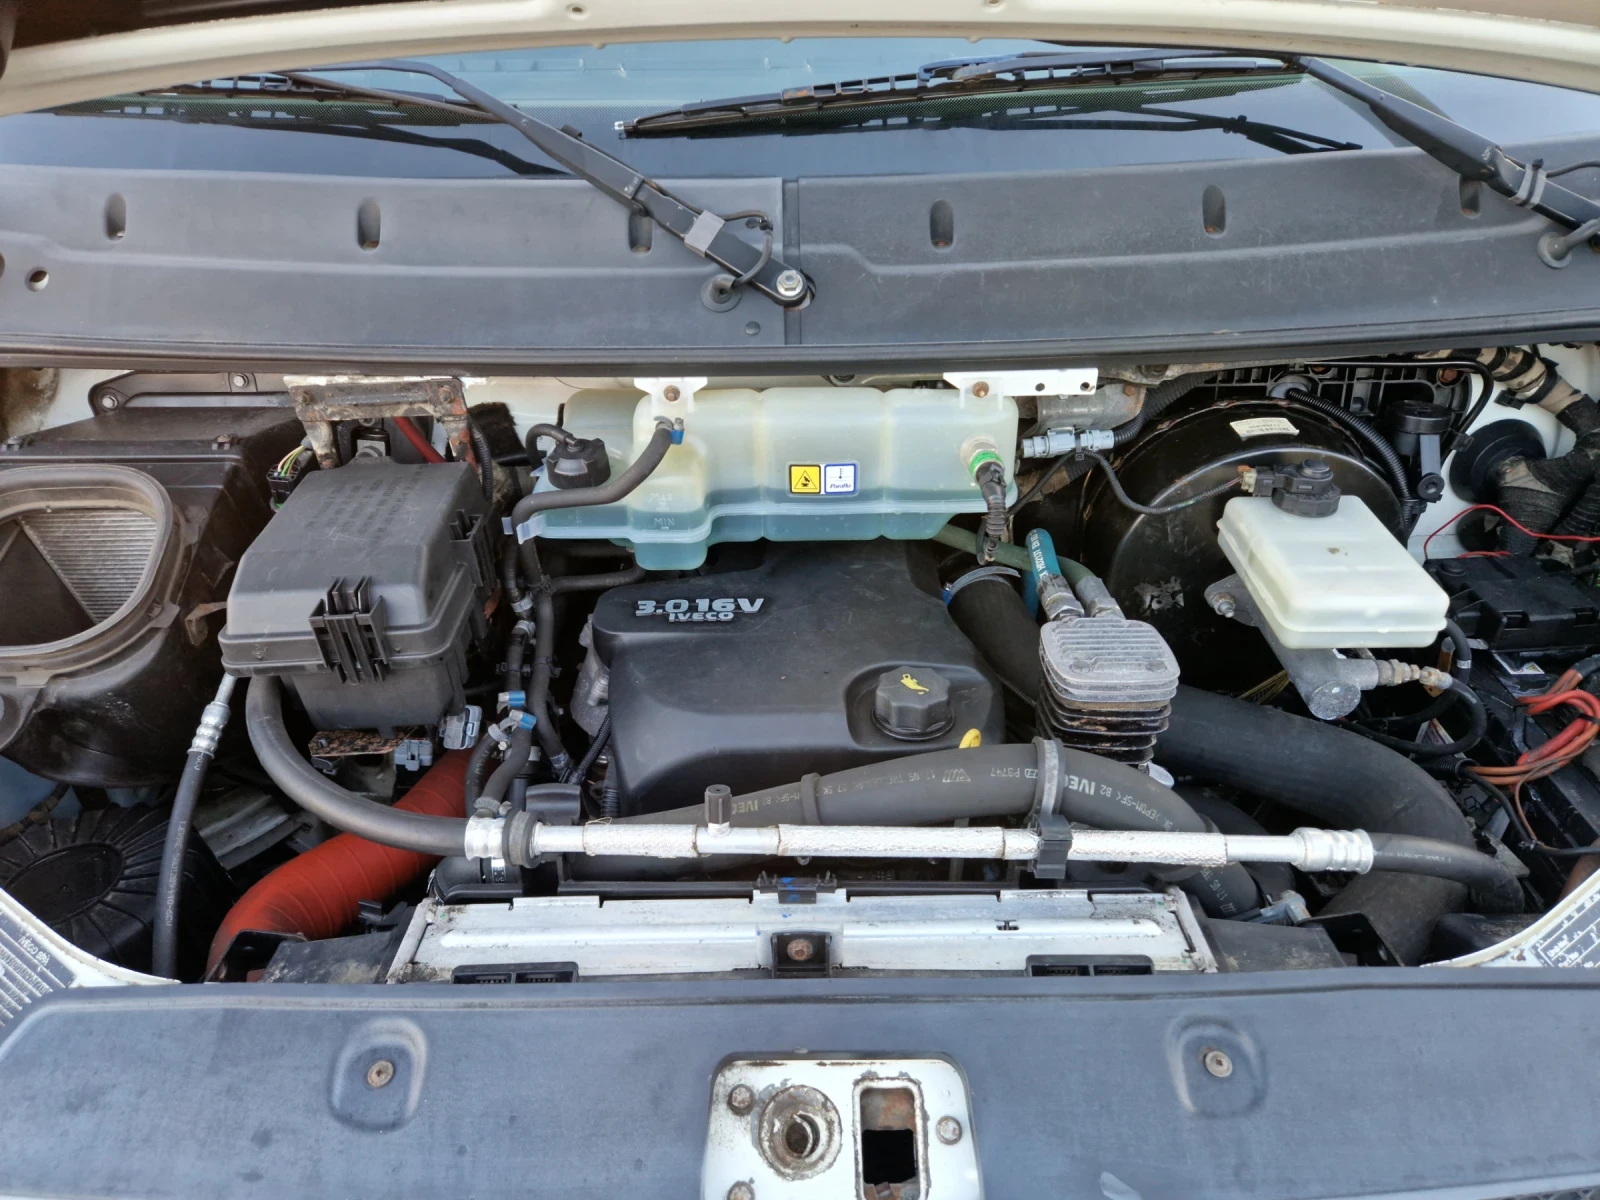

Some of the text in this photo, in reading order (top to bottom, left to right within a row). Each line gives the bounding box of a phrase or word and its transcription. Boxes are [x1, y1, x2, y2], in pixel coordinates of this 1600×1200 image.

[654, 518, 675, 526] MIN
[636, 598, 764, 616] 3.0 16V
[669, 612, 734, 622] IVECO
[1064, 774, 1095, 795] IVE
[1100, 784, 1112, 797] B2
[731, 799, 758, 814] IVEC
[18, 936, 38, 955] IVECO
